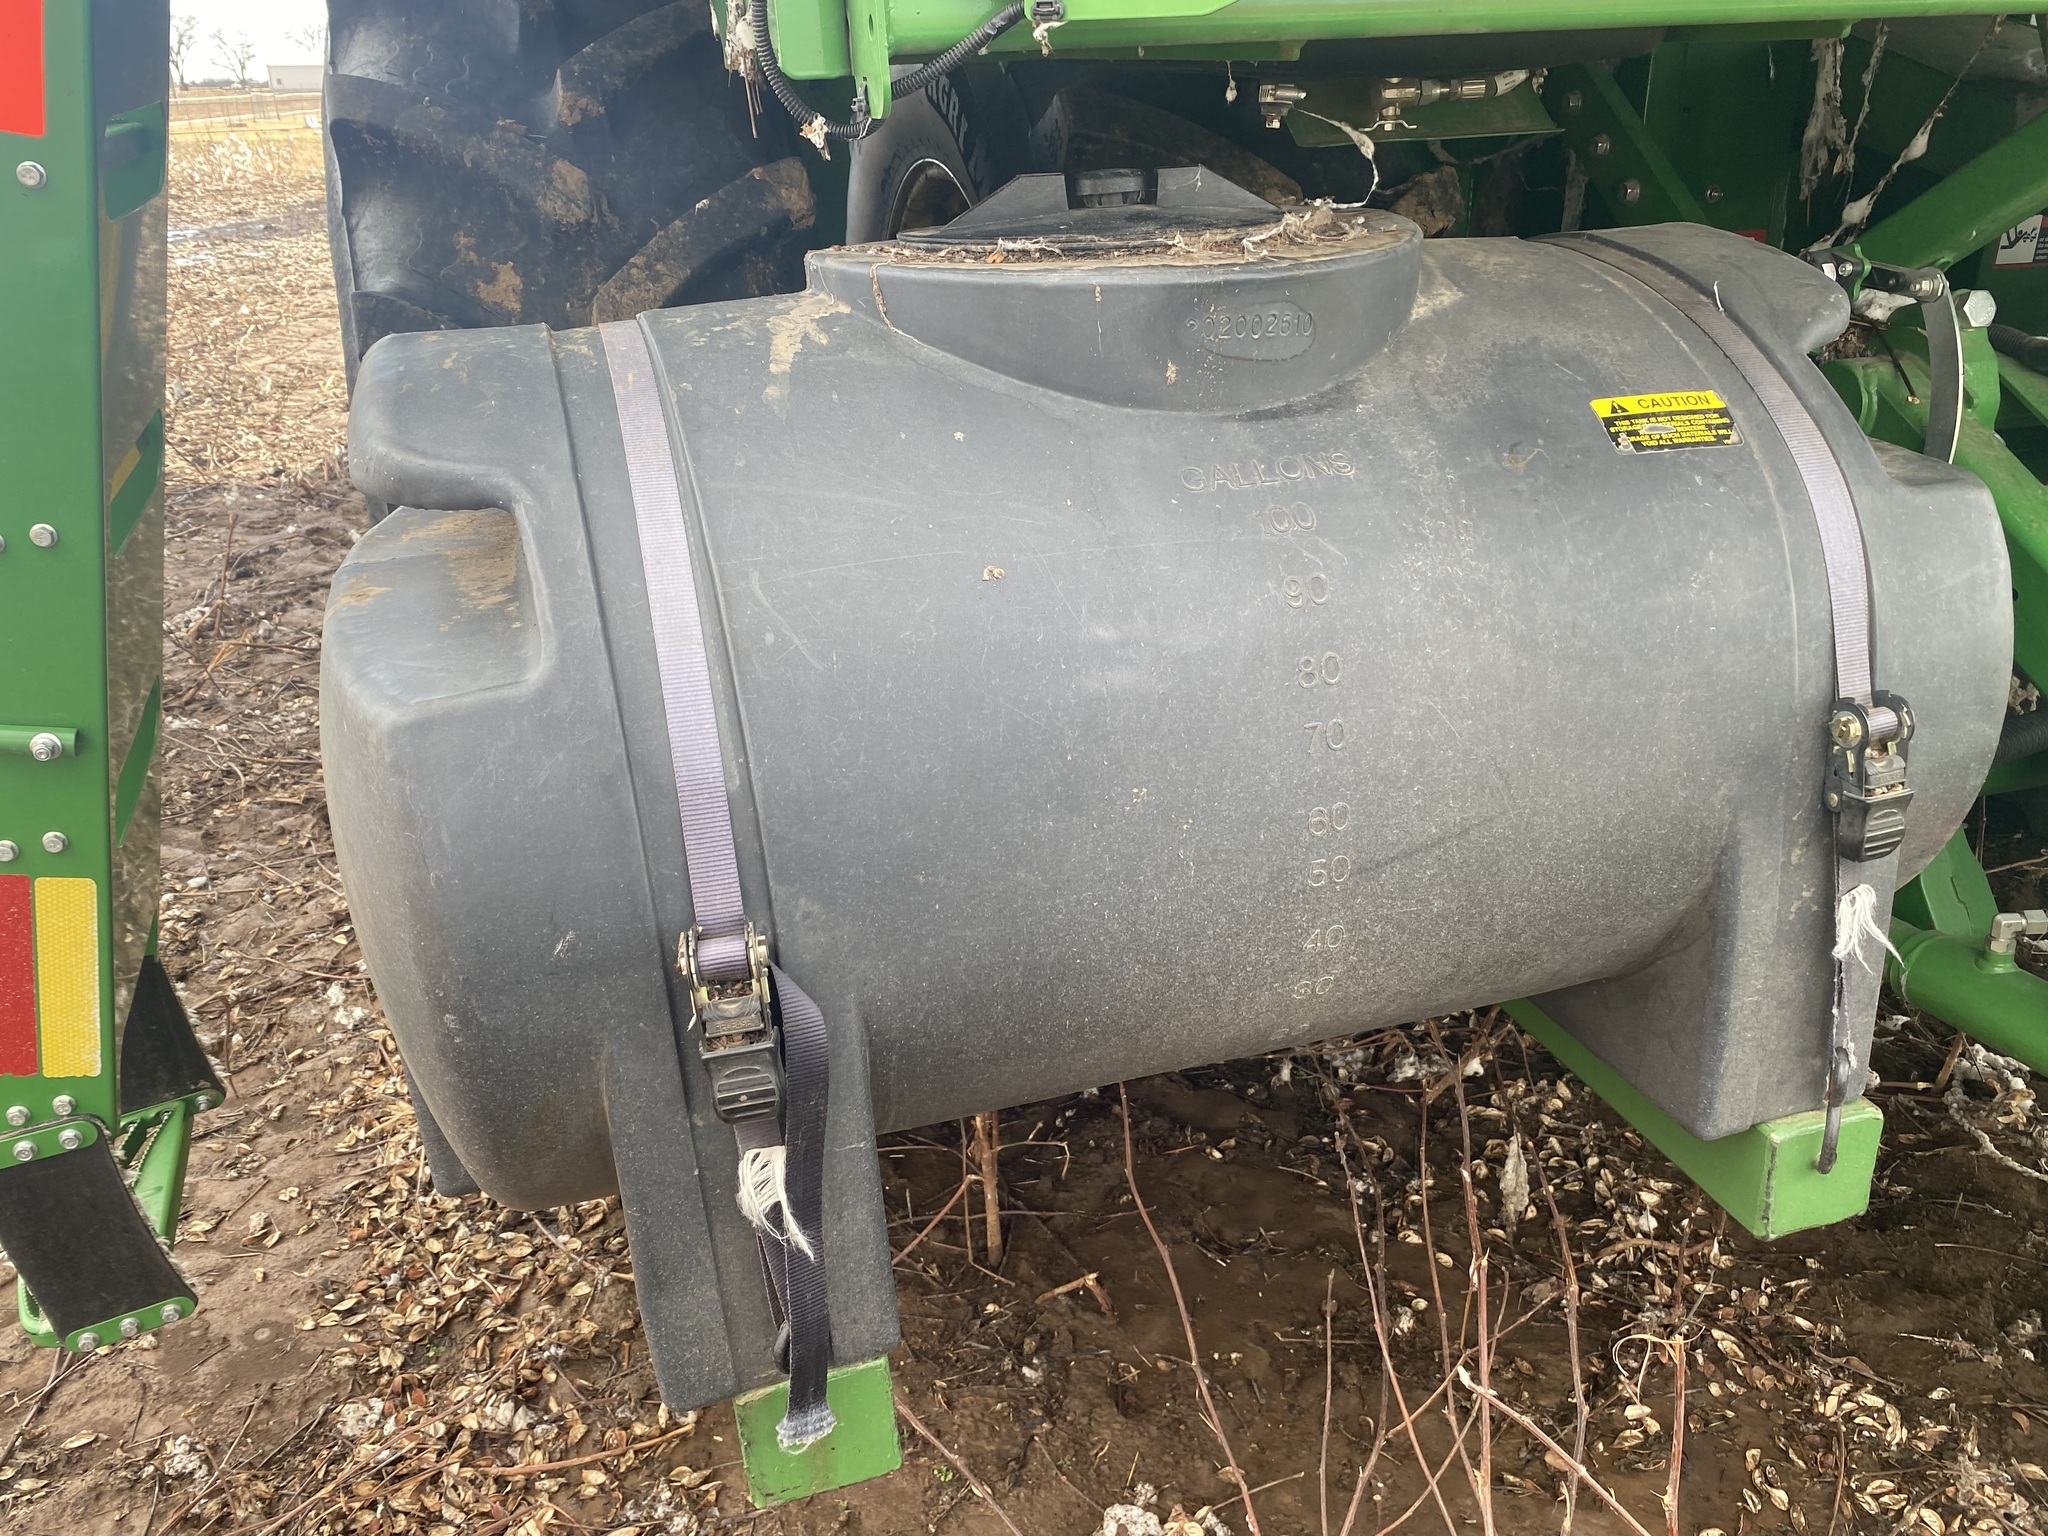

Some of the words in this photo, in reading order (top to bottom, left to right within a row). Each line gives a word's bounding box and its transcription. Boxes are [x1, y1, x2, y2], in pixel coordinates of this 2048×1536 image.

[1637, 395, 1711, 409] CAUTION
[1609, 424, 1642, 433] STORAGE
[1690, 417, 1731, 425] CONTAINING
[1617, 434, 1651, 443] SORAGE
[1661, 432, 1681, 440] SUCH
[1680, 429, 1717, 438] MATERIALS
[1179, 450, 1355, 493] GALLONS
[1283, 571, 1331, 609] 90
[1298, 652, 1342, 689] 80
[1303, 718, 1344, 754] 70
[1308, 801, 1351, 836] 60
[1308, 855, 1351, 887] 50
[1303, 924, 1346, 950] 40
[715, 1018, 752, 1031] RELEASE
